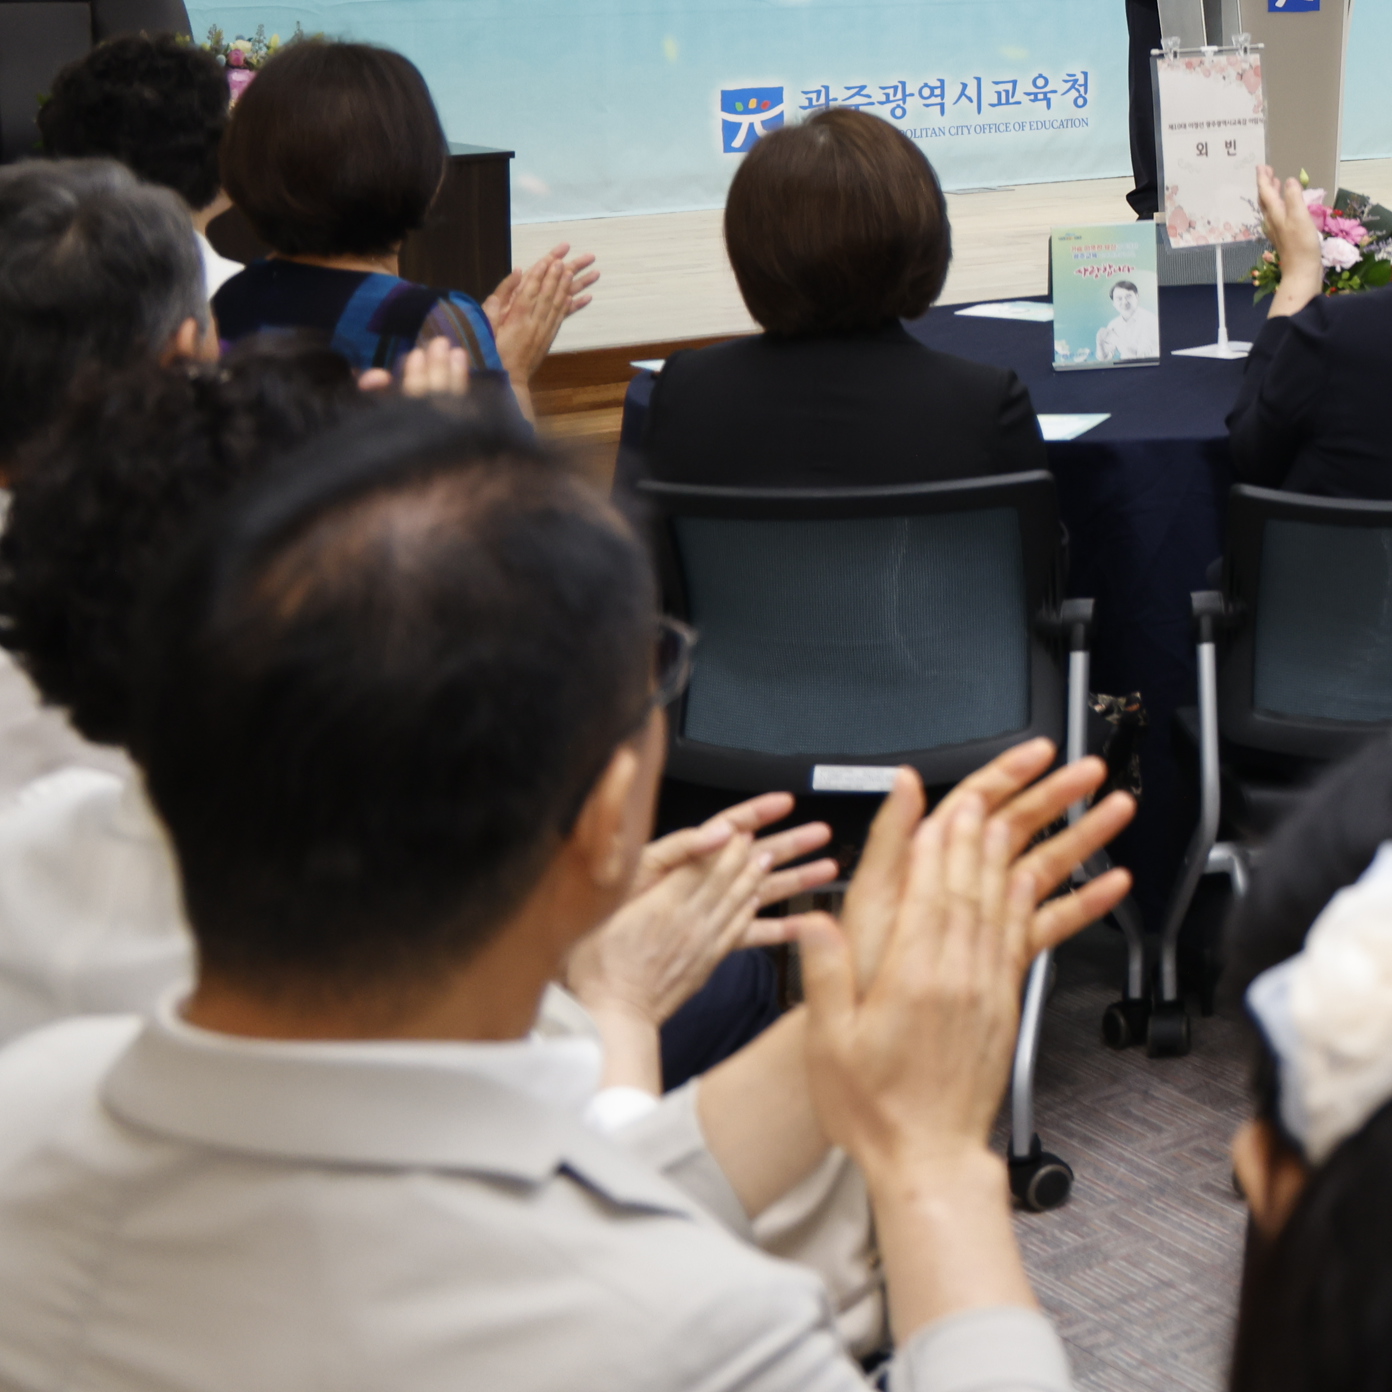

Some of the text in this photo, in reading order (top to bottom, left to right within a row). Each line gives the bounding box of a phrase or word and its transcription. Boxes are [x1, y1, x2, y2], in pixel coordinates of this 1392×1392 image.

[948, 124, 972, 136] CITY
[974, 122, 1012, 135] OFFICE
[1013, 120, 1027, 131] OF
[1029, 118, 1089, 131] EDUCATION
[1196, 139, 1237, 158] 외 빈
